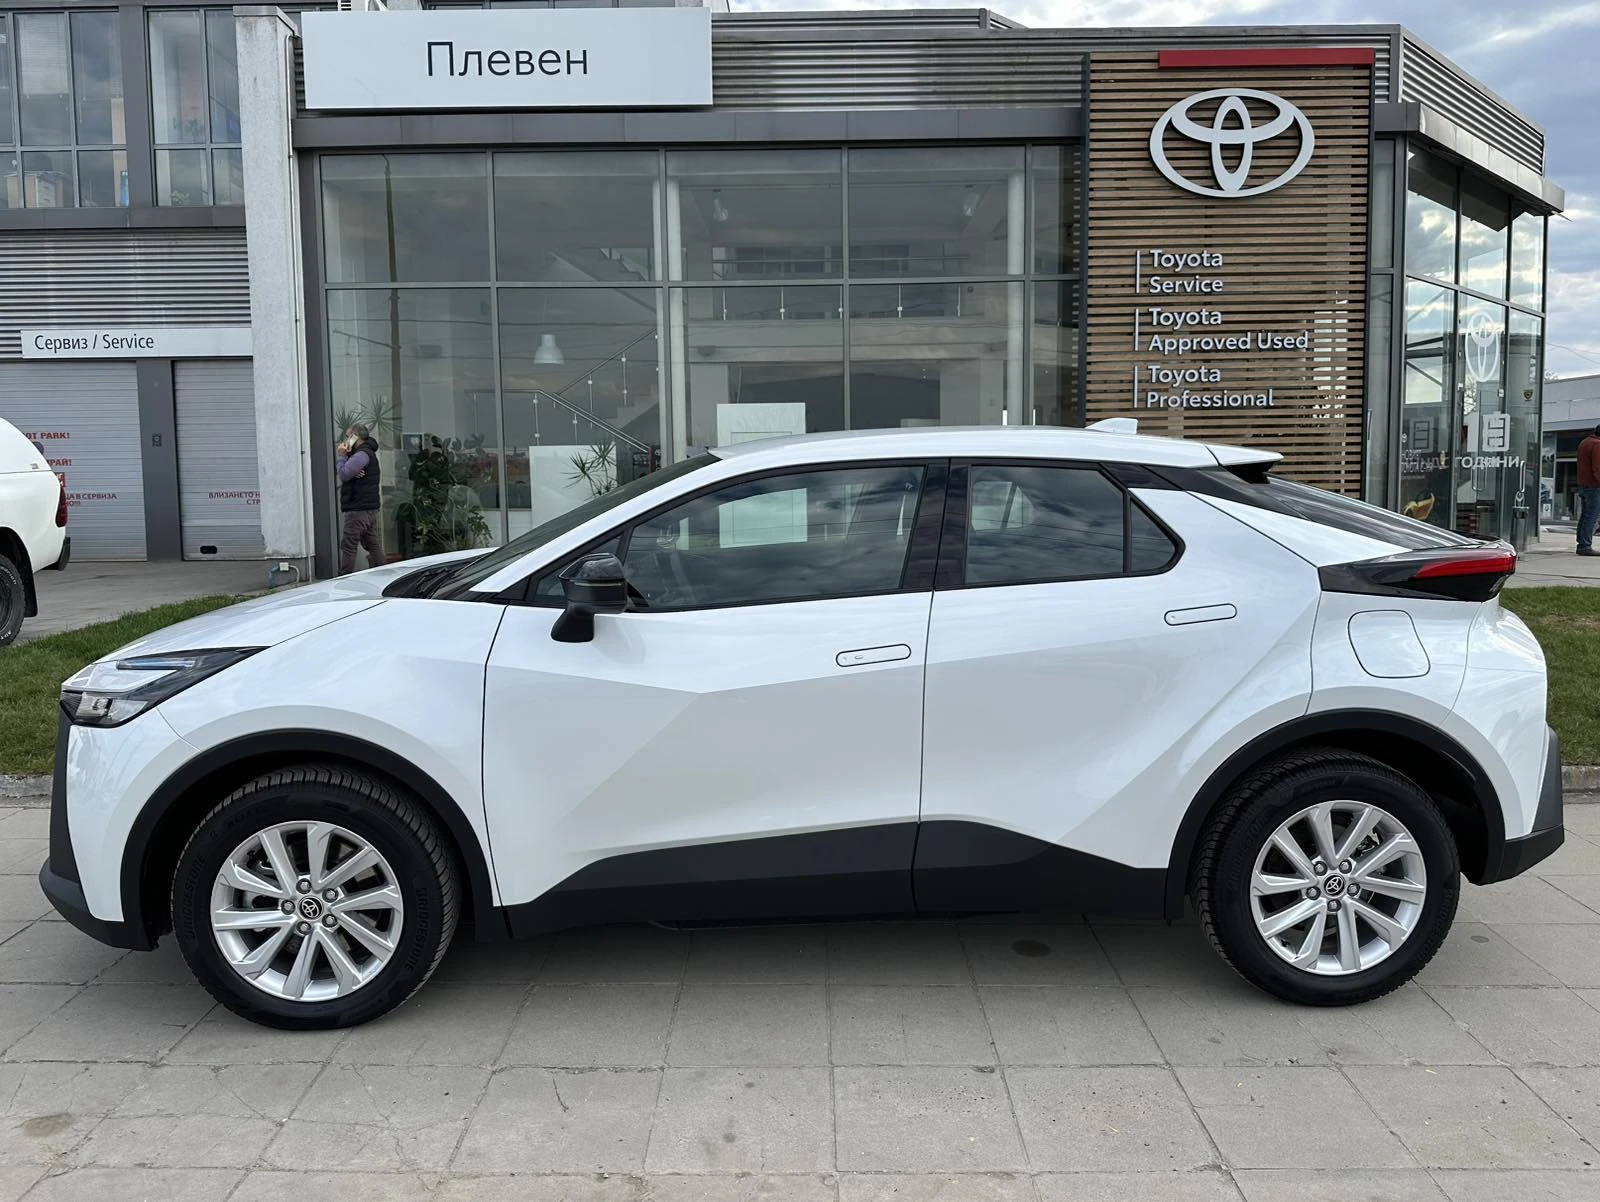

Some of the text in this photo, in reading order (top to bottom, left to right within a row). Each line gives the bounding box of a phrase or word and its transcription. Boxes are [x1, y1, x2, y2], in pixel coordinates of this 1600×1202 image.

[427, 41, 587, 76] Плевен
[1149, 249, 1223, 272] Toyota
[1149, 275, 1223, 293] Service
[1148, 308, 1222, 330] Toyota
[34, 333, 154, 354] Сервиз / Service
[1148, 331, 1309, 355] Approved Used
[1147, 365, 1221, 387] Toyota
[1146, 389, 1275, 408] Professional
